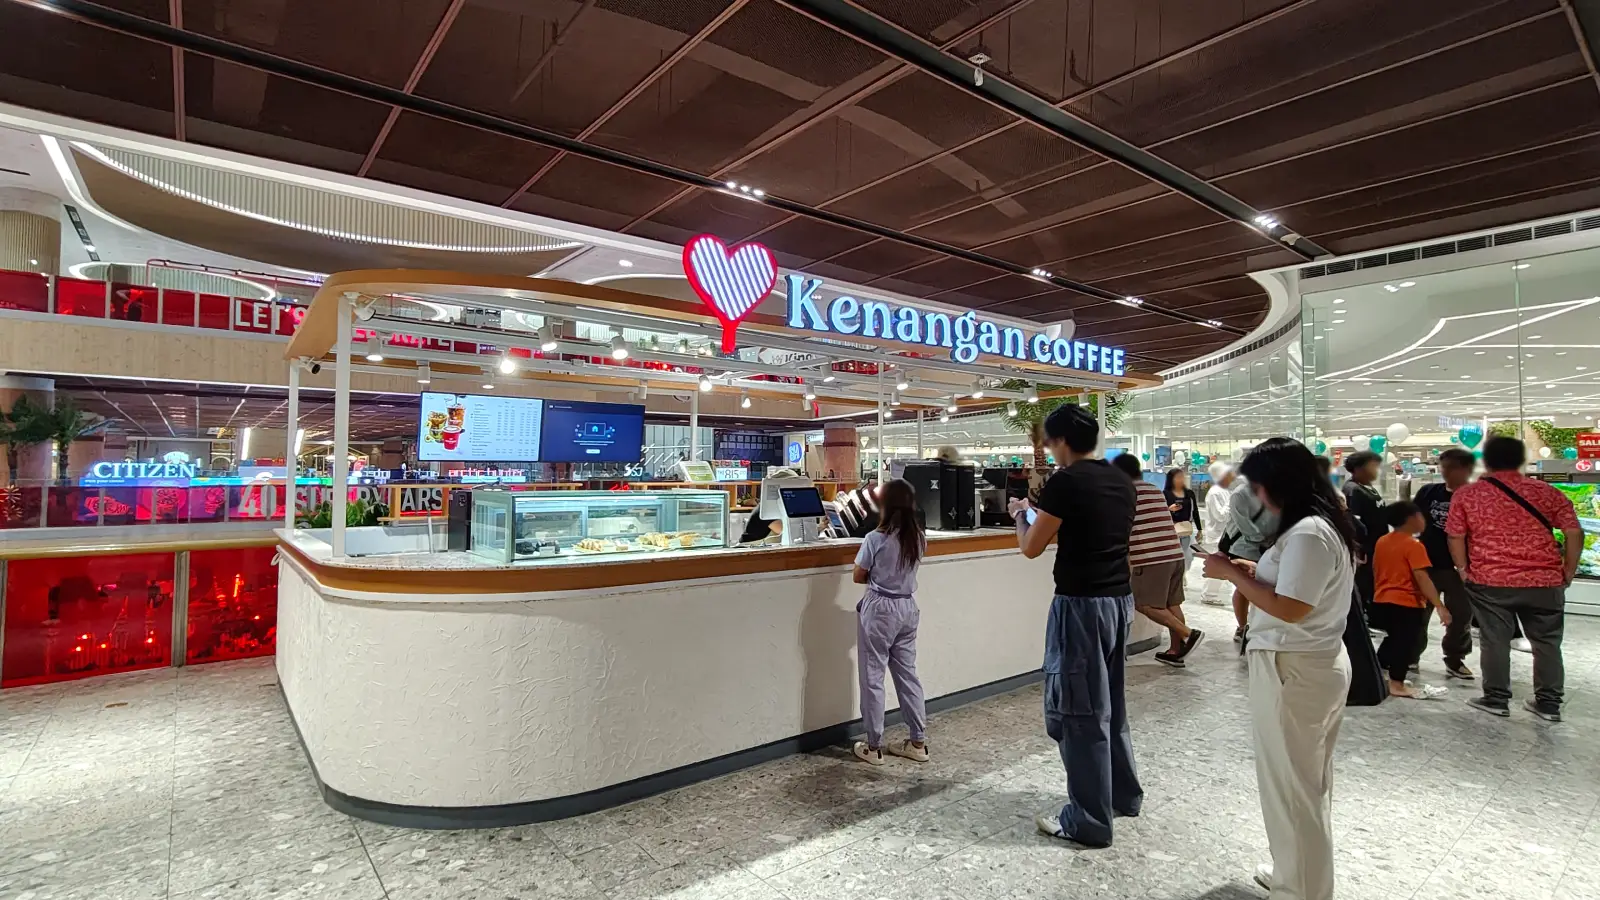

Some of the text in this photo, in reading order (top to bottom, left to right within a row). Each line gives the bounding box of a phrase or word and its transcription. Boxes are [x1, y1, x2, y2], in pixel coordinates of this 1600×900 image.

[786, 274, 1126, 377] Kenangan COFFEE
[93, 462, 196, 478] CITIZEN
